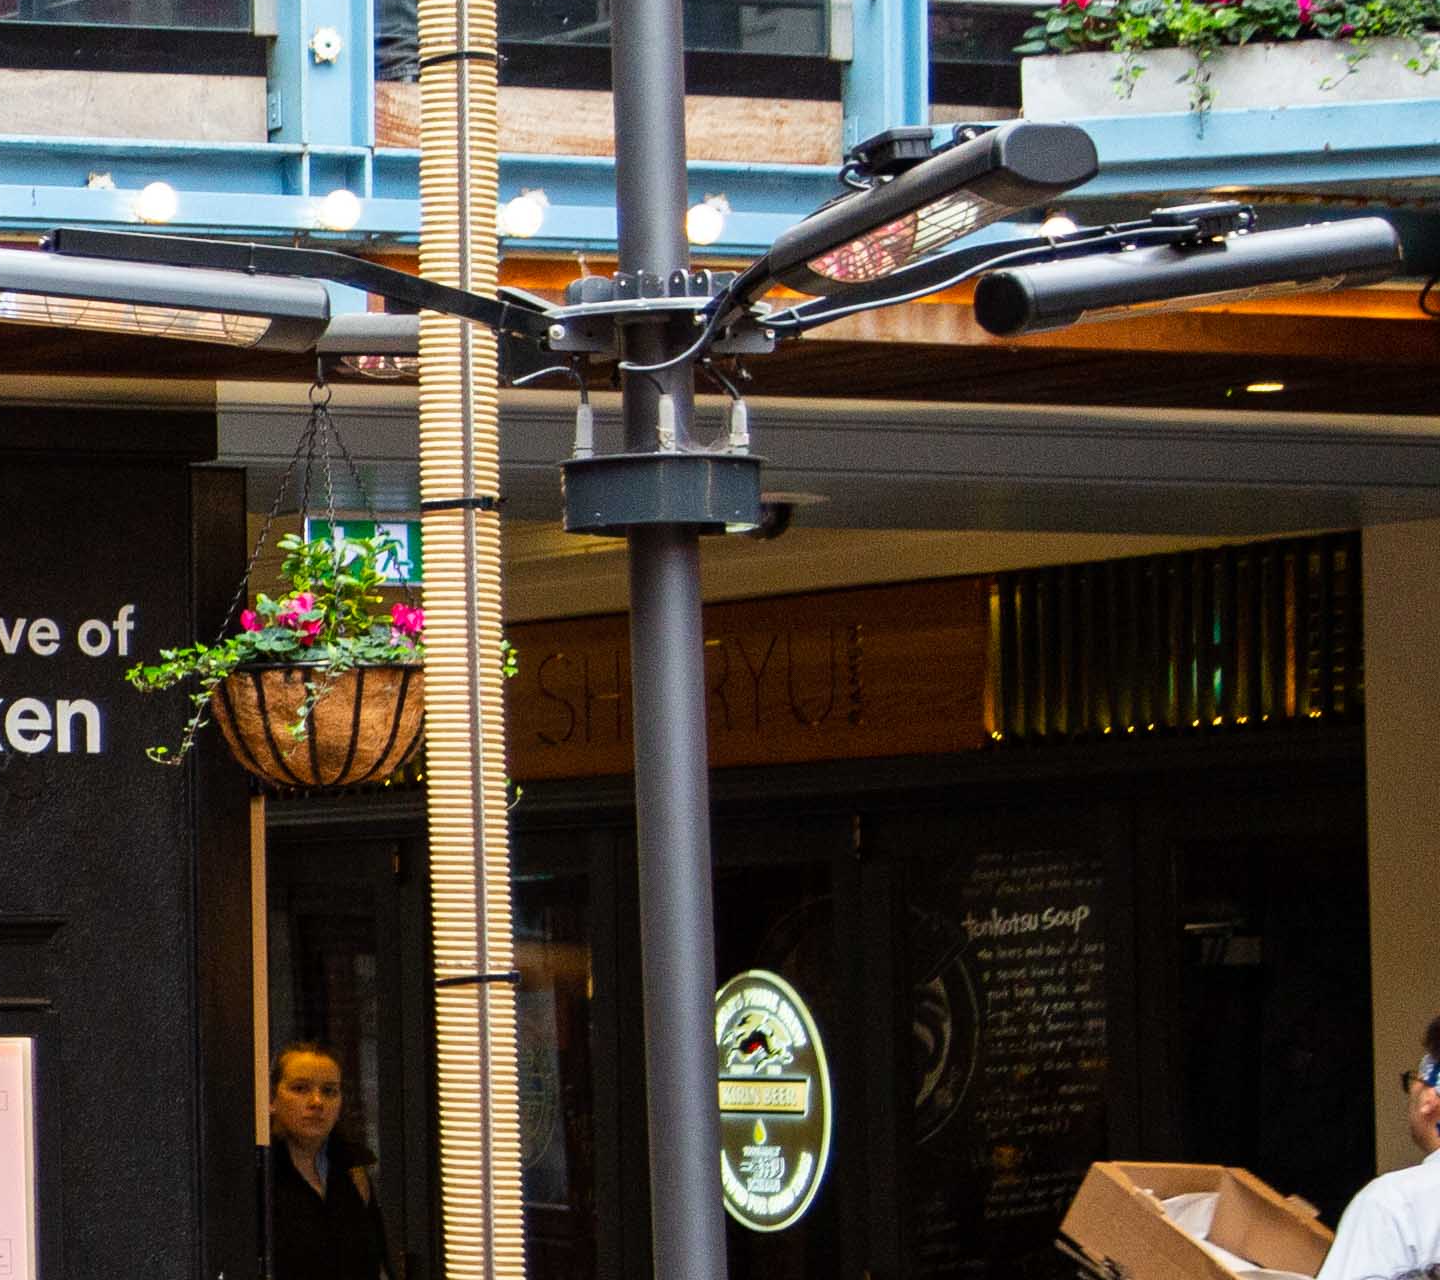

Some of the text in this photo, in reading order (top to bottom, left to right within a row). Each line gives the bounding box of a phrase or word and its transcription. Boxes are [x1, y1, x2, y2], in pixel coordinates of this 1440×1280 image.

[77, 604, 135, 657] of
[537, 630, 837, 746] SHRYU
[764, 1087, 797, 1107] BEER
